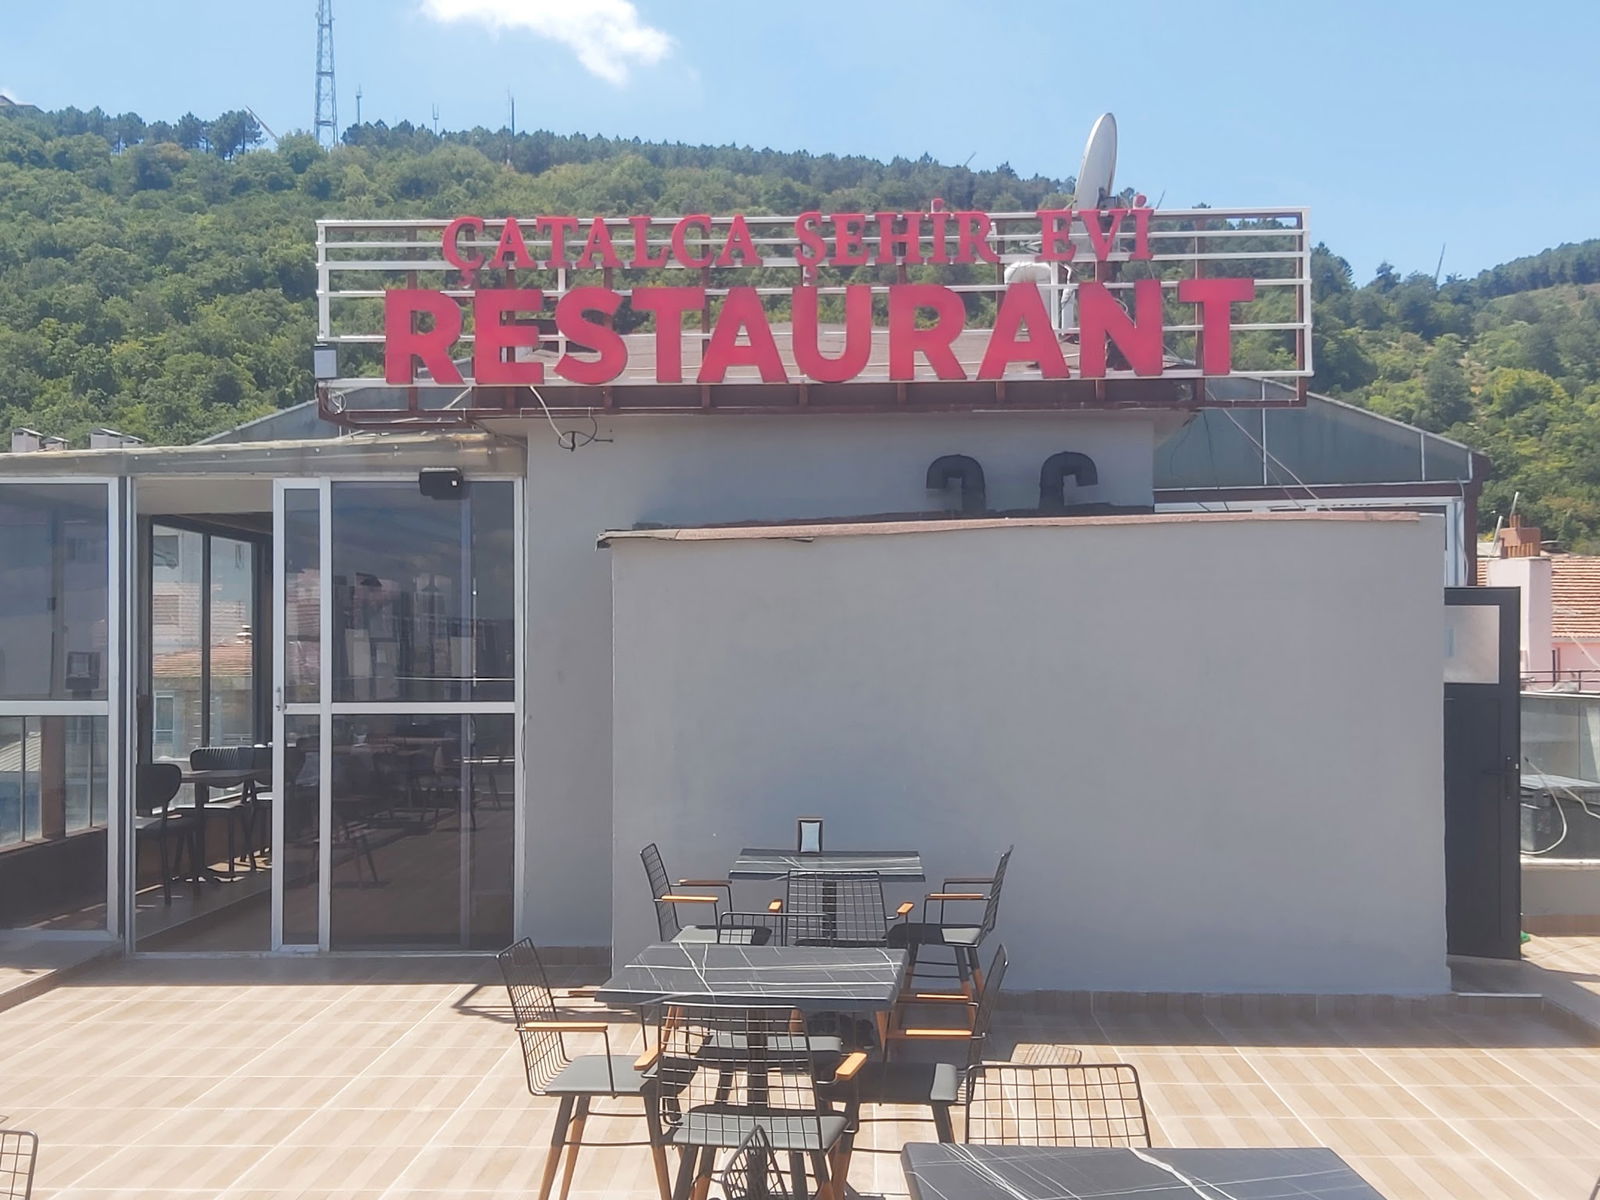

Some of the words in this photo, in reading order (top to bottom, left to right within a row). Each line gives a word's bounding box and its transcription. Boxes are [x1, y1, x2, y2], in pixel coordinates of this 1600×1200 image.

[442, 214, 763, 288] ÇATALCA
[794, 197, 1001, 284] ŞEHİR
[1035, 194, 1155, 262] EVİ
[385, 278, 1255, 385] RESTAURANT
